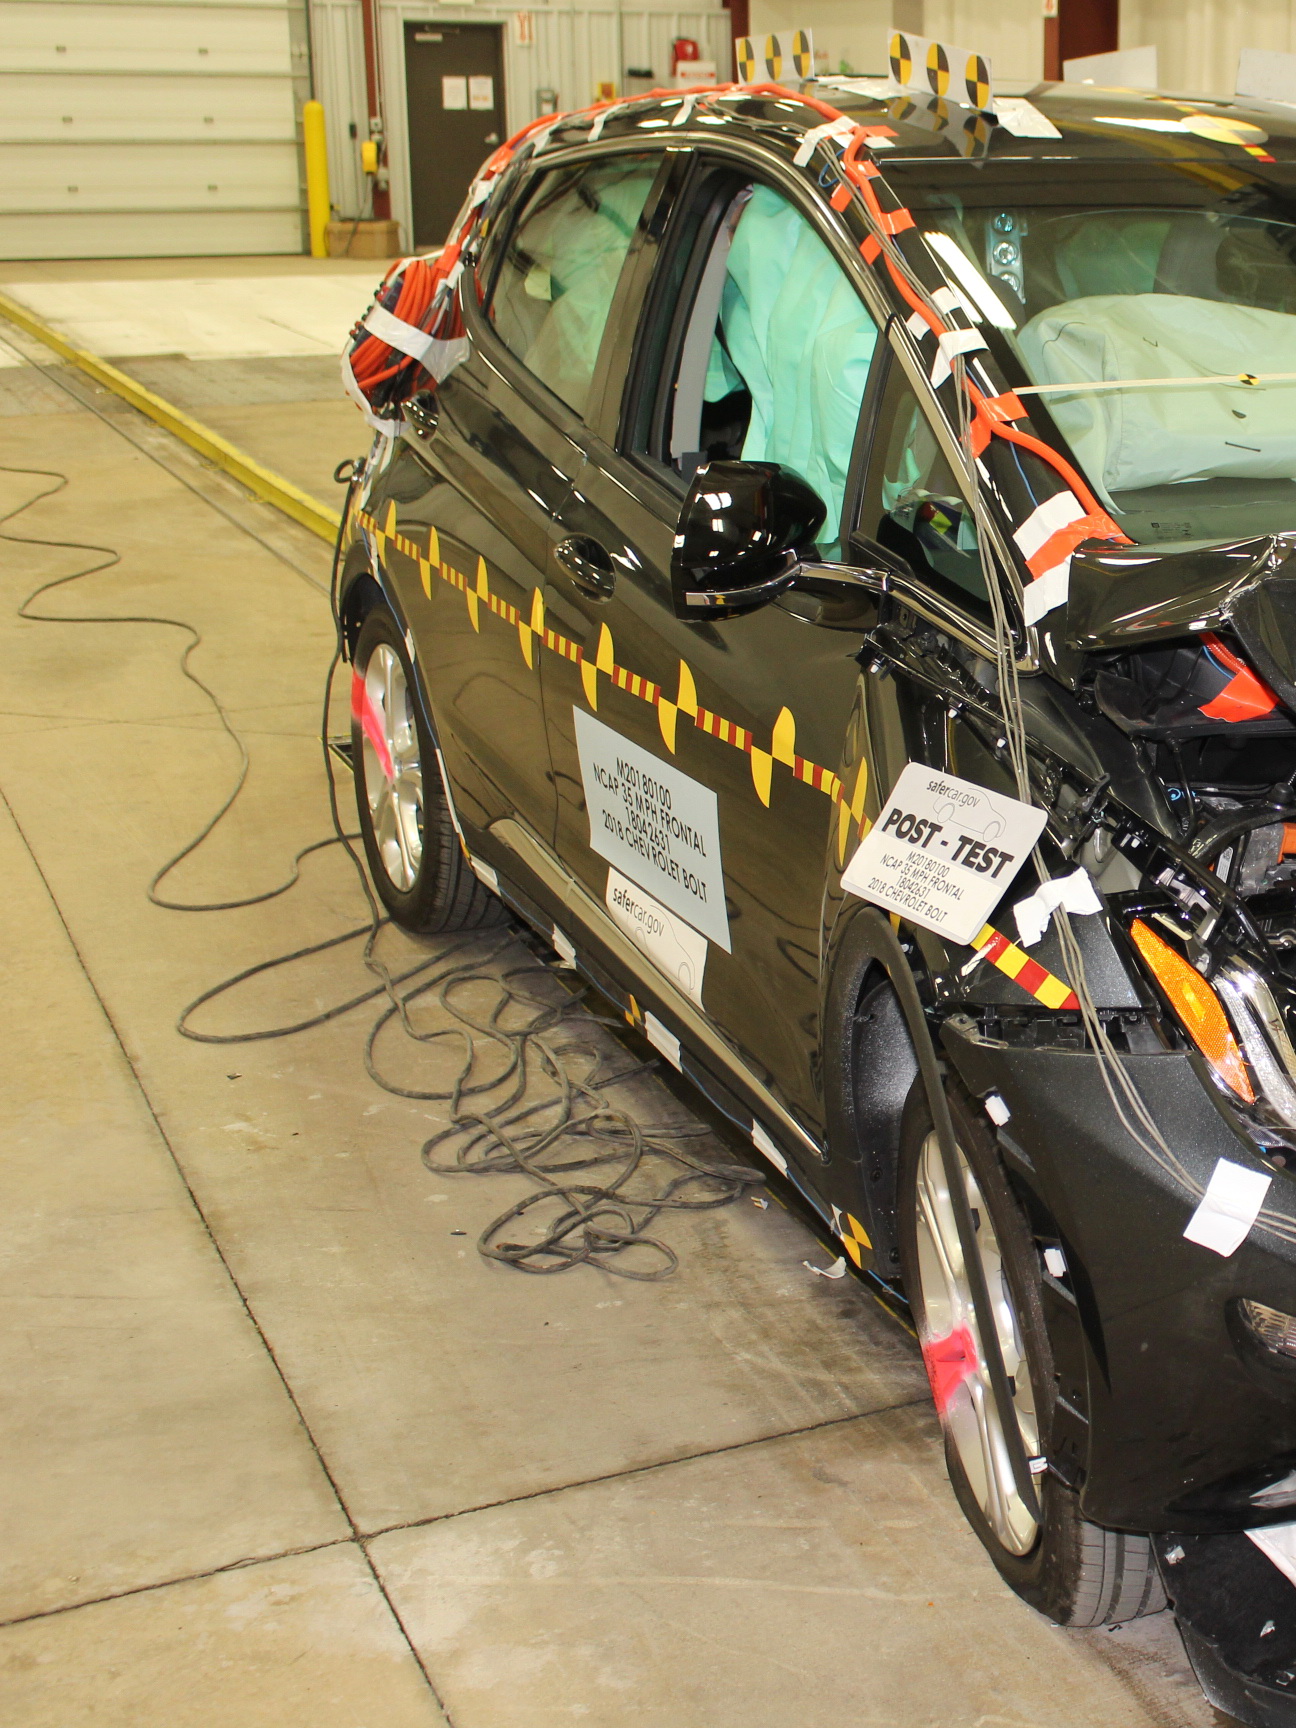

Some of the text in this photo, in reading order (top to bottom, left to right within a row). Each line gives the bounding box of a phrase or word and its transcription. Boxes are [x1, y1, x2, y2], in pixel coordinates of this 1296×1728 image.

[616, 757, 672, 810] M20180100
[926, 779, 980, 808] safercar.gov
[593, 762, 707, 857] NCAP 35 MPH FRONTAL
[625, 806, 671, 854] 18042631
[602, 809, 707, 903] 2018 CHEVROLET BOLT
[881, 808, 943, 849] POST
[951, 835, 1015, 879] TEST
[906, 851, 950, 878] M20180100
[868, 877, 948, 922] 2018 CHEVROLET BOLT
[880, 854, 965, 900] NCAP 35 MPH FRONTAL
[612, 886, 665, 937] safercar.gov
